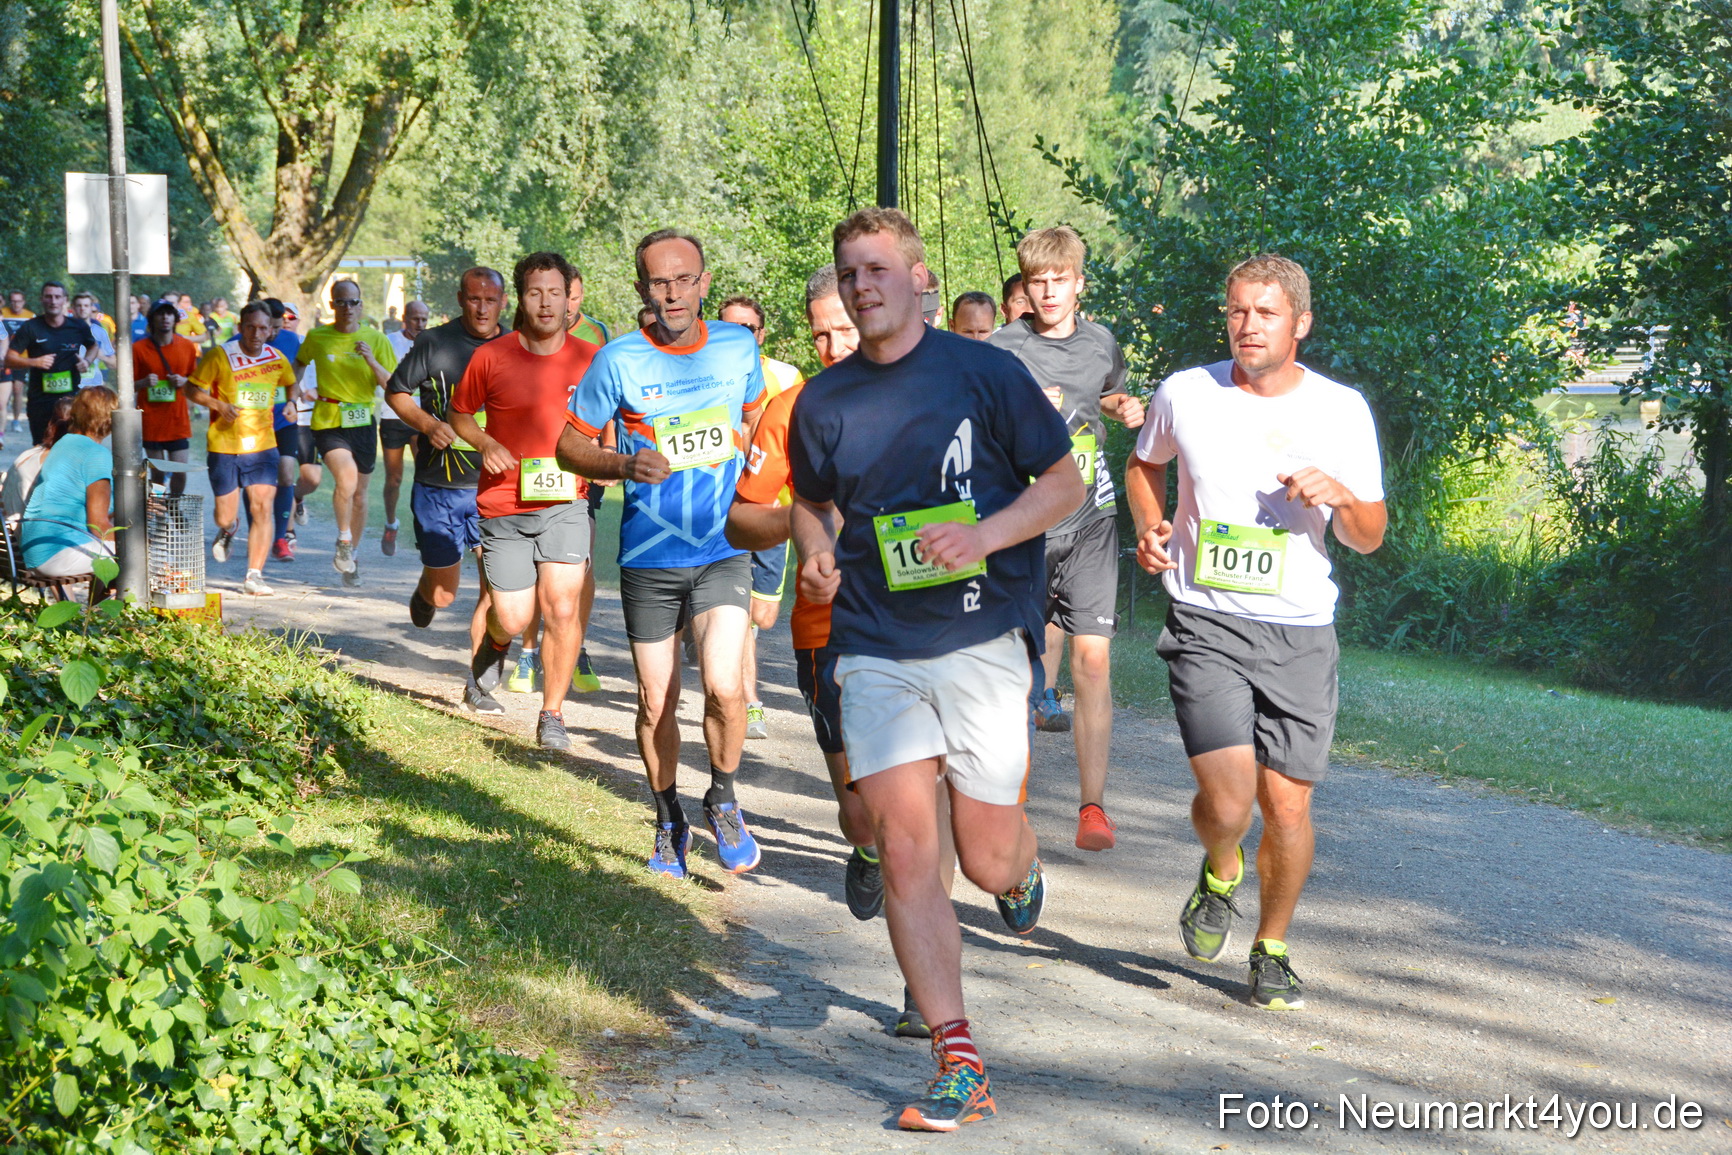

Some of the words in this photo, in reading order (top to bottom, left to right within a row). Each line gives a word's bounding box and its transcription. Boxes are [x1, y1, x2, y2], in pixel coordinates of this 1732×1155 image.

[234, 371, 257, 382] MAX
[665, 375, 714, 388] Raiffeisenbank
[46, 379, 68, 388] 2035
[667, 385, 701, 396] Neumarkt
[241, 391, 268, 402] 1236
[347, 409, 366, 420] 938
[667, 427, 723, 455] 1579
[533, 473, 563, 488] 451
[1209, 545, 1273, 574] 1010
[897, 566, 939, 577] Sokolowski
[1213, 569, 1243, 580] Schuster
[1244, 574, 1264, 582] Franz
